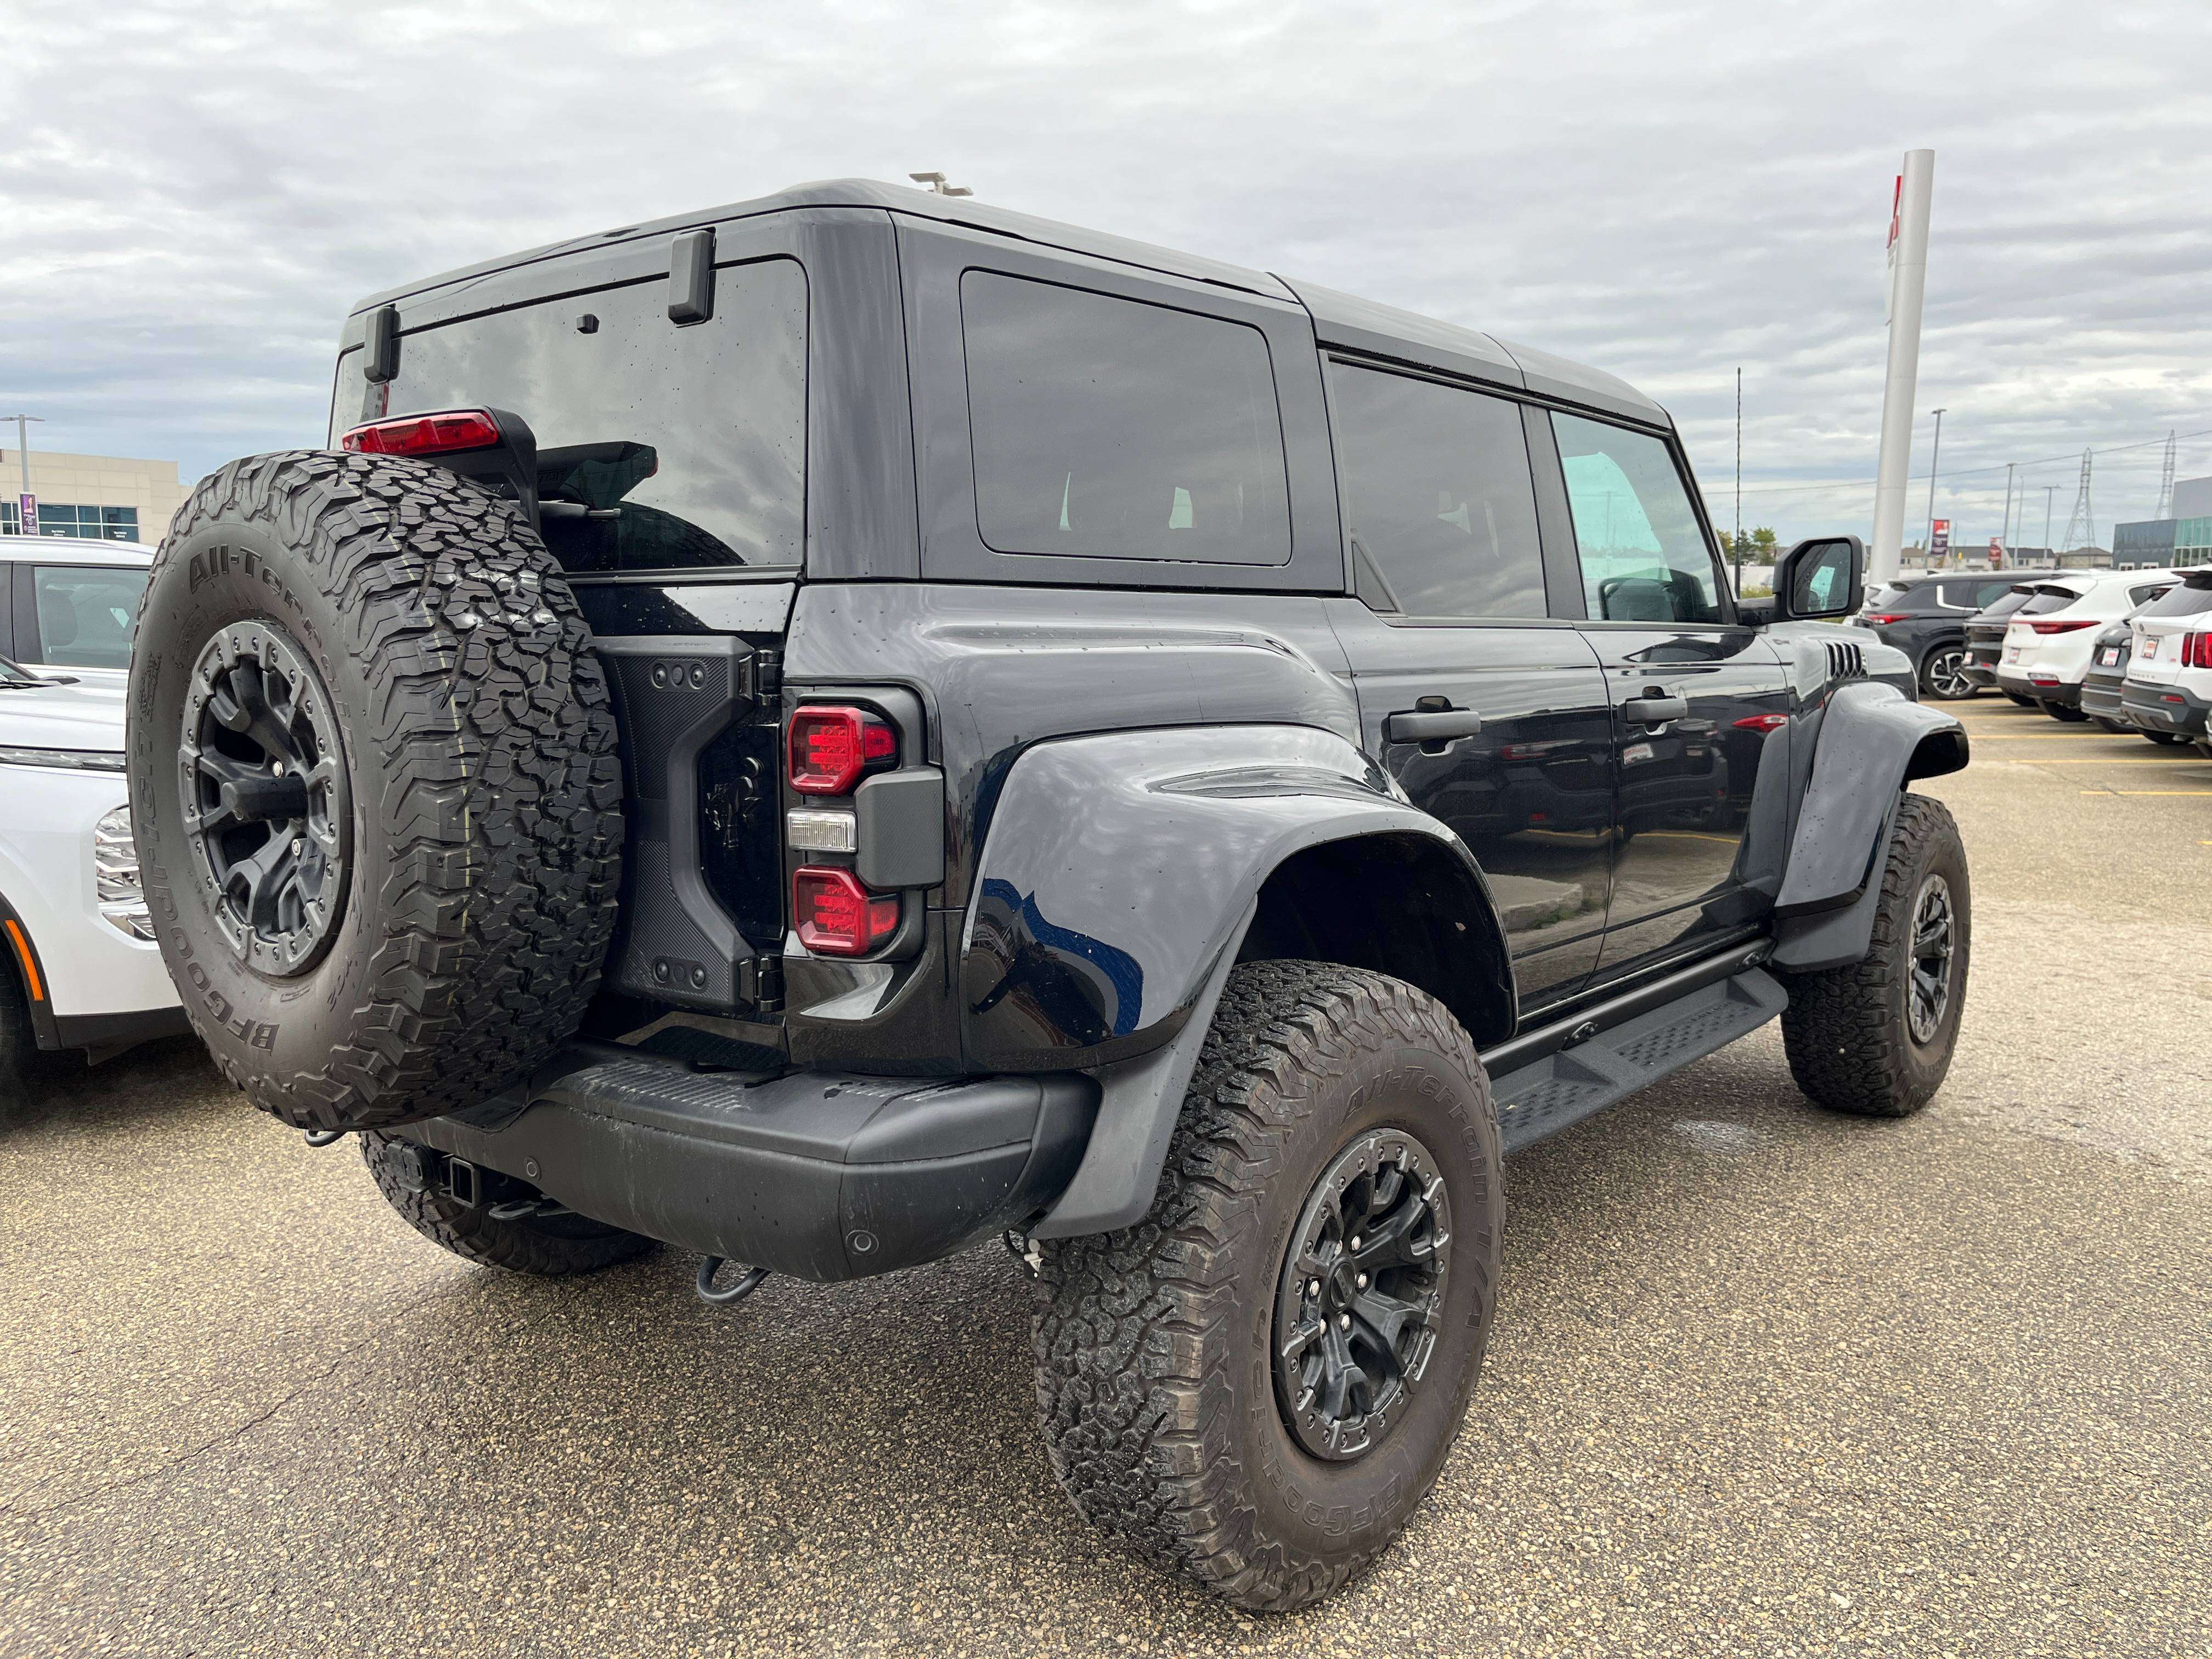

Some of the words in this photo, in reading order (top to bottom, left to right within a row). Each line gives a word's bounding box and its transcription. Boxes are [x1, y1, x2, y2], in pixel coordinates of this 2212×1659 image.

[189, 544, 358, 771] All-Terrain
[134, 729, 280, 1052] BFGoodrich
[1340, 1065, 1488, 1204] All-Terrain
[1465, 1223, 1493, 1329] T/A
[1250, 1306, 1402, 1537] BFGoodrich
